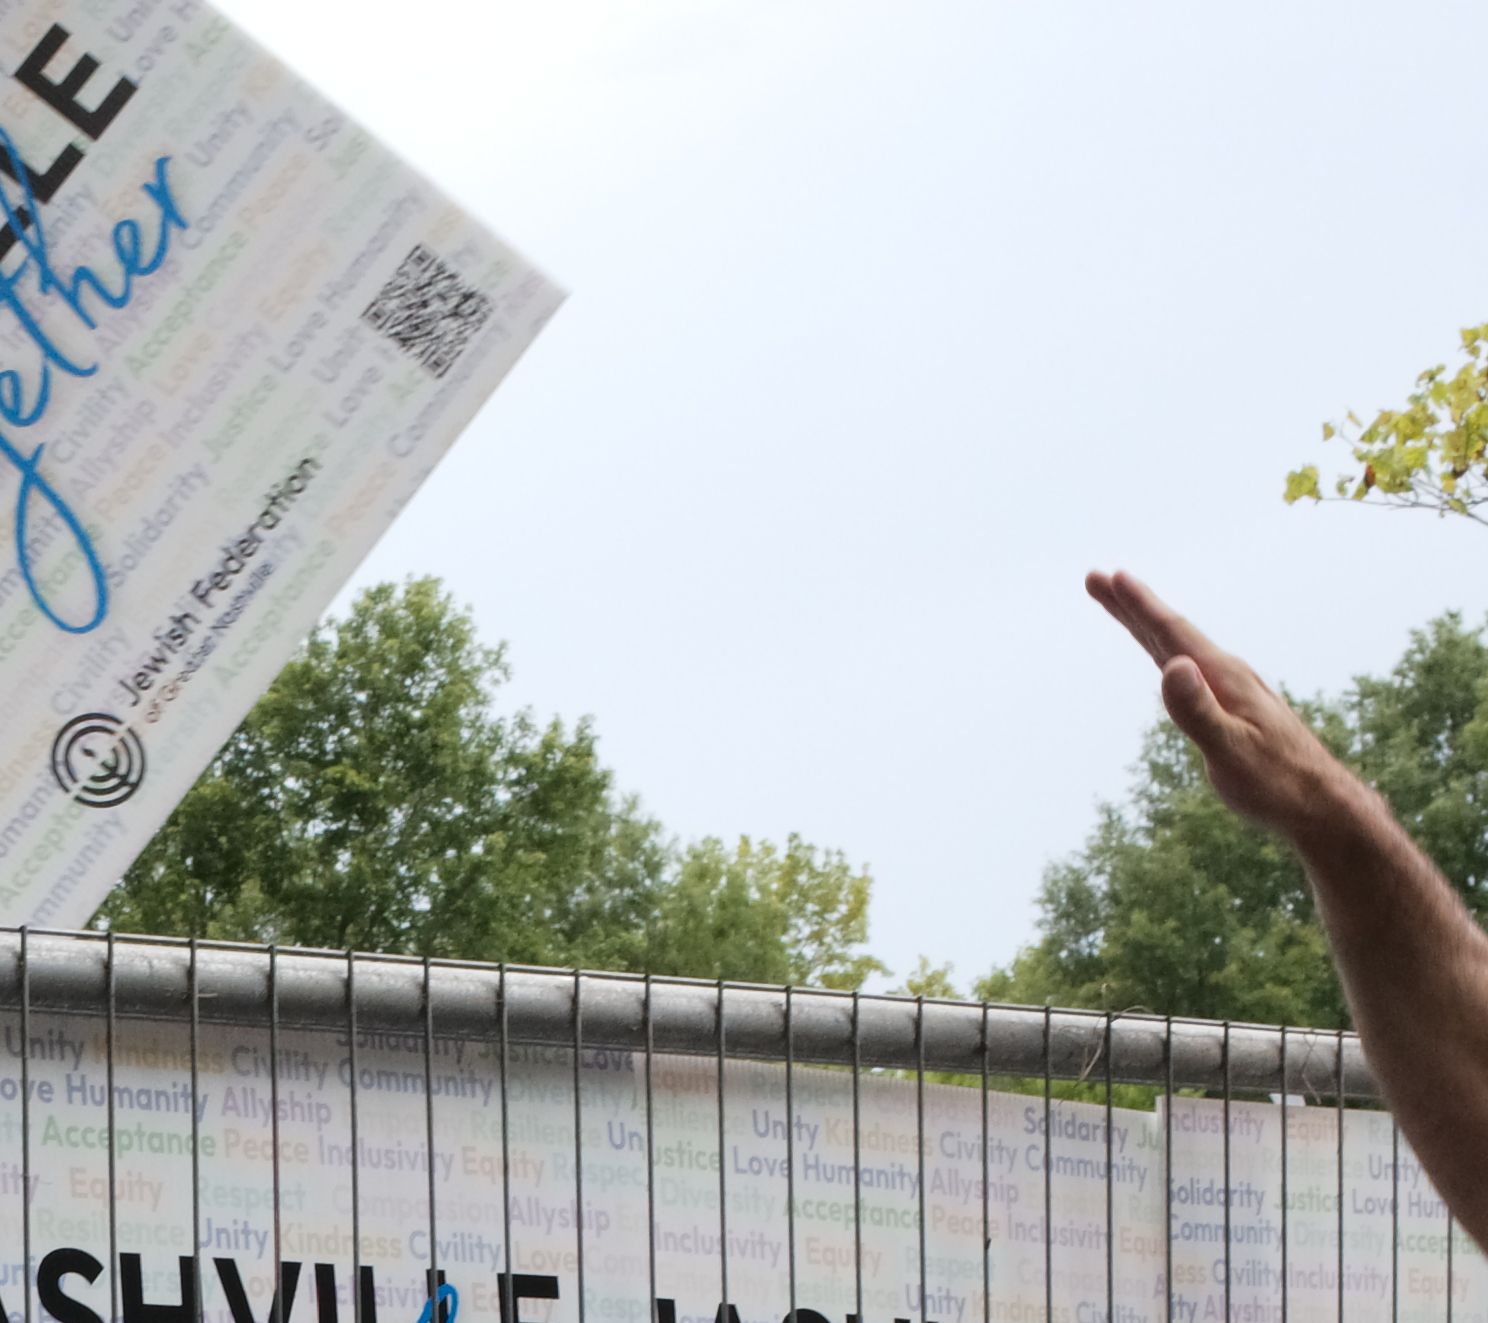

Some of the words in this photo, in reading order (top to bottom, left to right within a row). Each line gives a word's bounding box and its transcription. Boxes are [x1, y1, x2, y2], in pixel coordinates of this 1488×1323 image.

[118, 612, 202, 706] Jewish
[190, 457, 322, 609] Federation
[65, 1073, 208, 1124] Humanity
[732, 1145, 791, 1178] Love
[802, 1151, 922, 1198] Humanity
